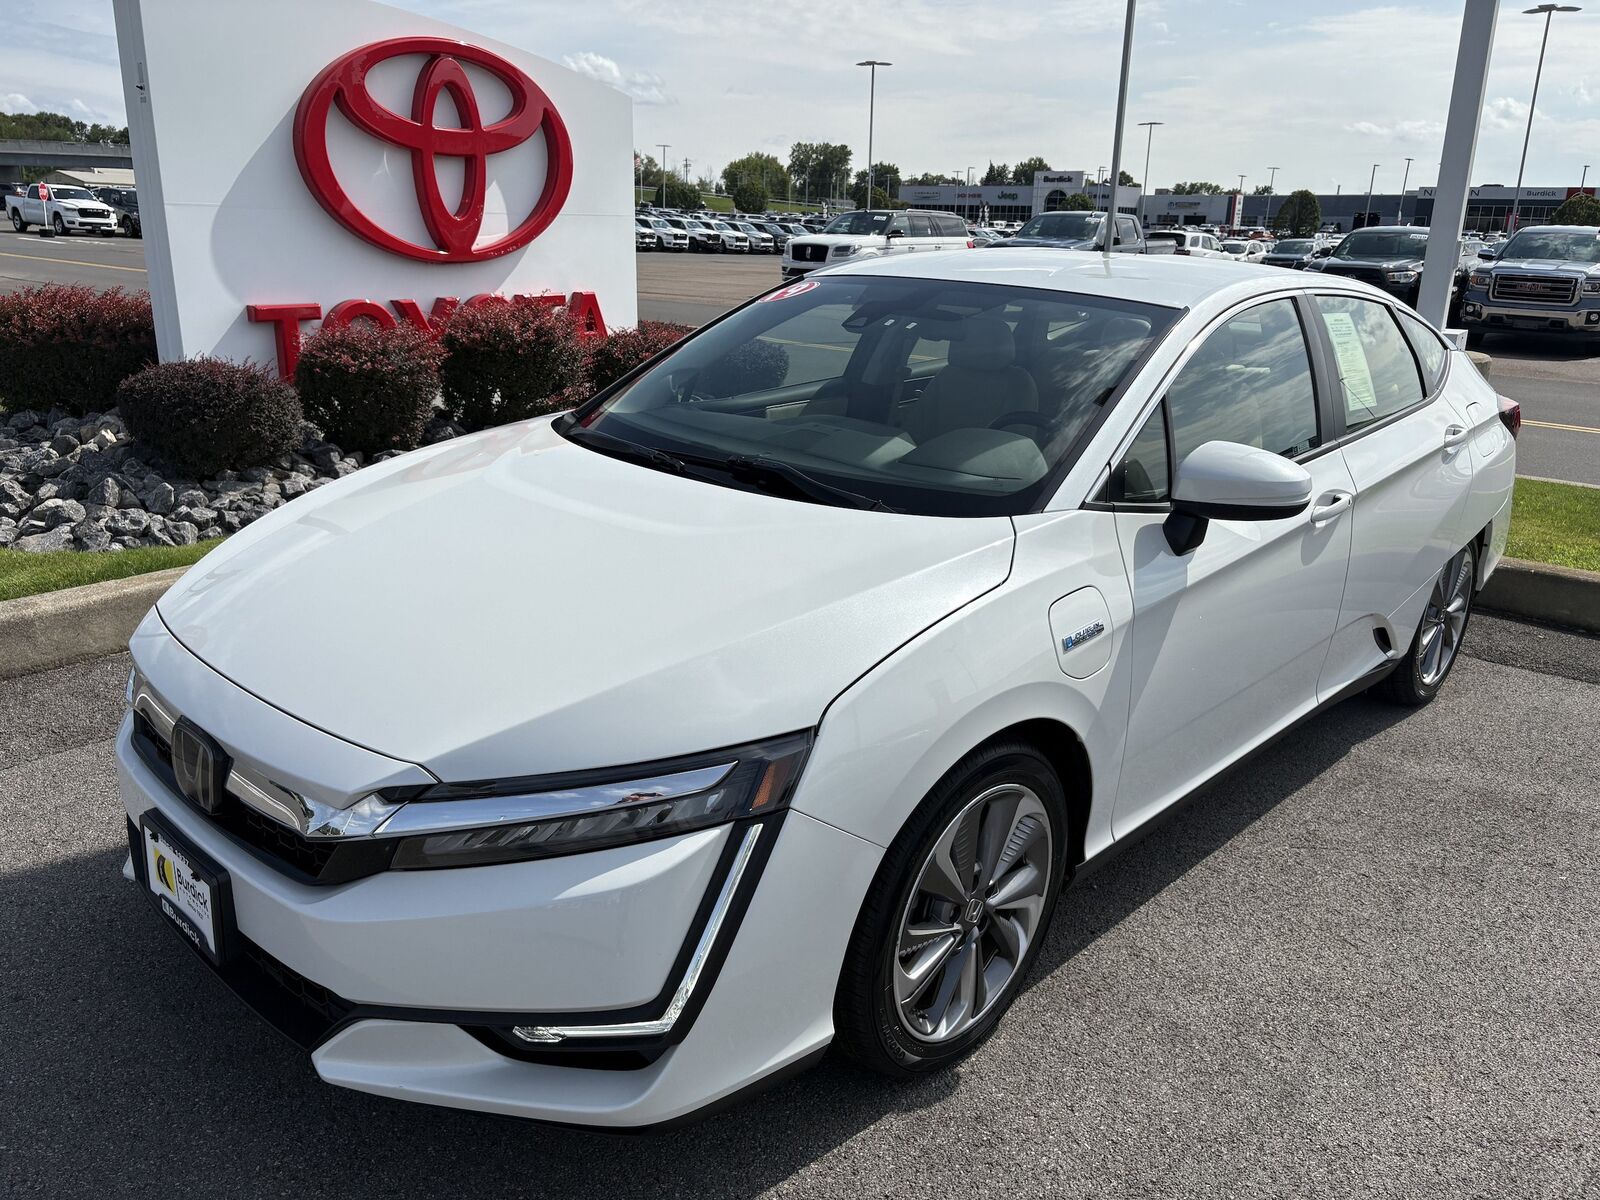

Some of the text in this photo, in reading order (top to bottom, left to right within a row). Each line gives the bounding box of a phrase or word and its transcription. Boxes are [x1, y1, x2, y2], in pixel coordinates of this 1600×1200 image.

[997, 191, 1018, 201] Jeep
[1043, 175, 1073, 183] Burdick
[246, 291, 609, 384] TYA
[176, 868, 209, 912] Burdick
[169, 906, 200, 949] Burdick
